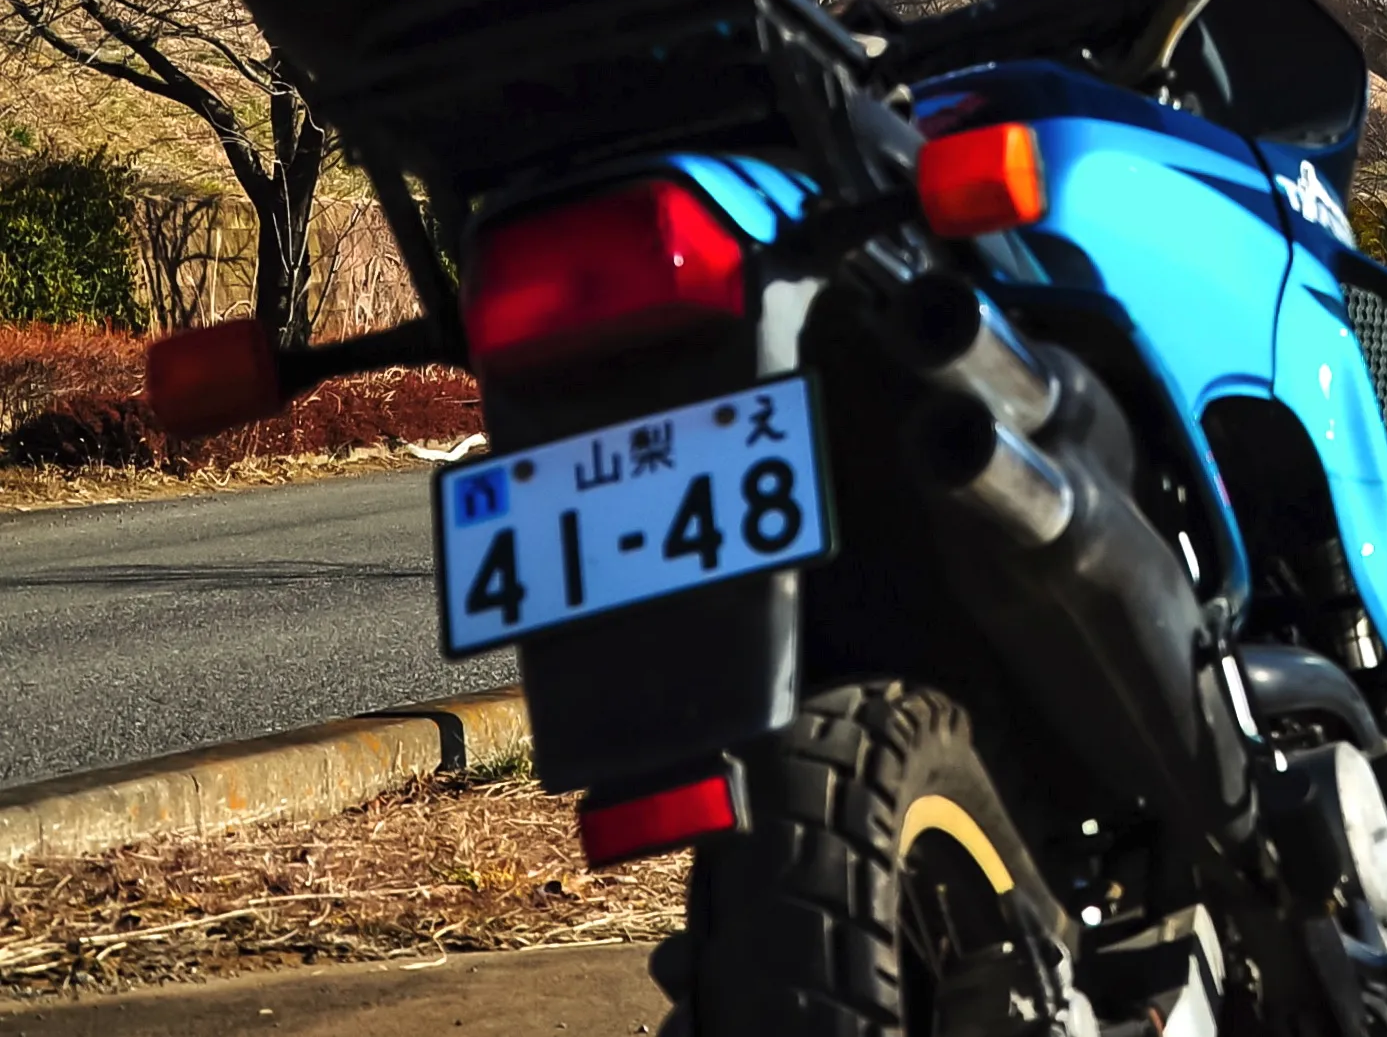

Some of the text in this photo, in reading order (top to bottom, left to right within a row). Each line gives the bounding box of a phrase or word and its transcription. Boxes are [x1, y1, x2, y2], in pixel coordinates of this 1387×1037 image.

[574, 394, 786, 491] 山梨 え
[464, 456, 804, 626] 41-48
